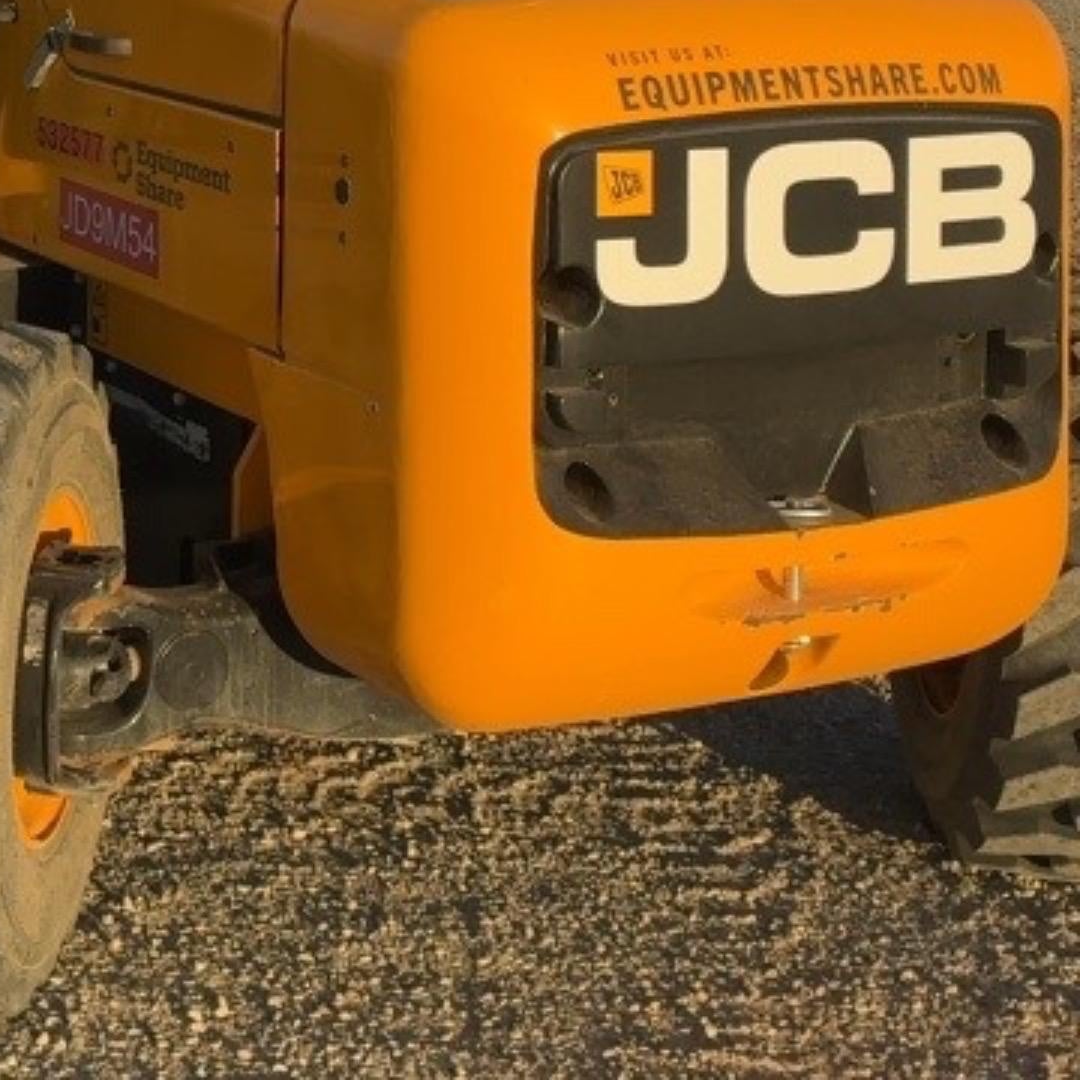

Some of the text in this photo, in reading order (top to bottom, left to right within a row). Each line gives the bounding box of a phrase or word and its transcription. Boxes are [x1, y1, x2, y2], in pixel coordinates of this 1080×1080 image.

[606, 45, 731, 67] VISIT US AT:
[617, 62, 1003, 112] EQUIPMENTSHARE.COM
[135, 140, 232, 194] Equipment
[62, 191, 157, 263] JD9M54
[596, 131, 1037, 308] JCB
